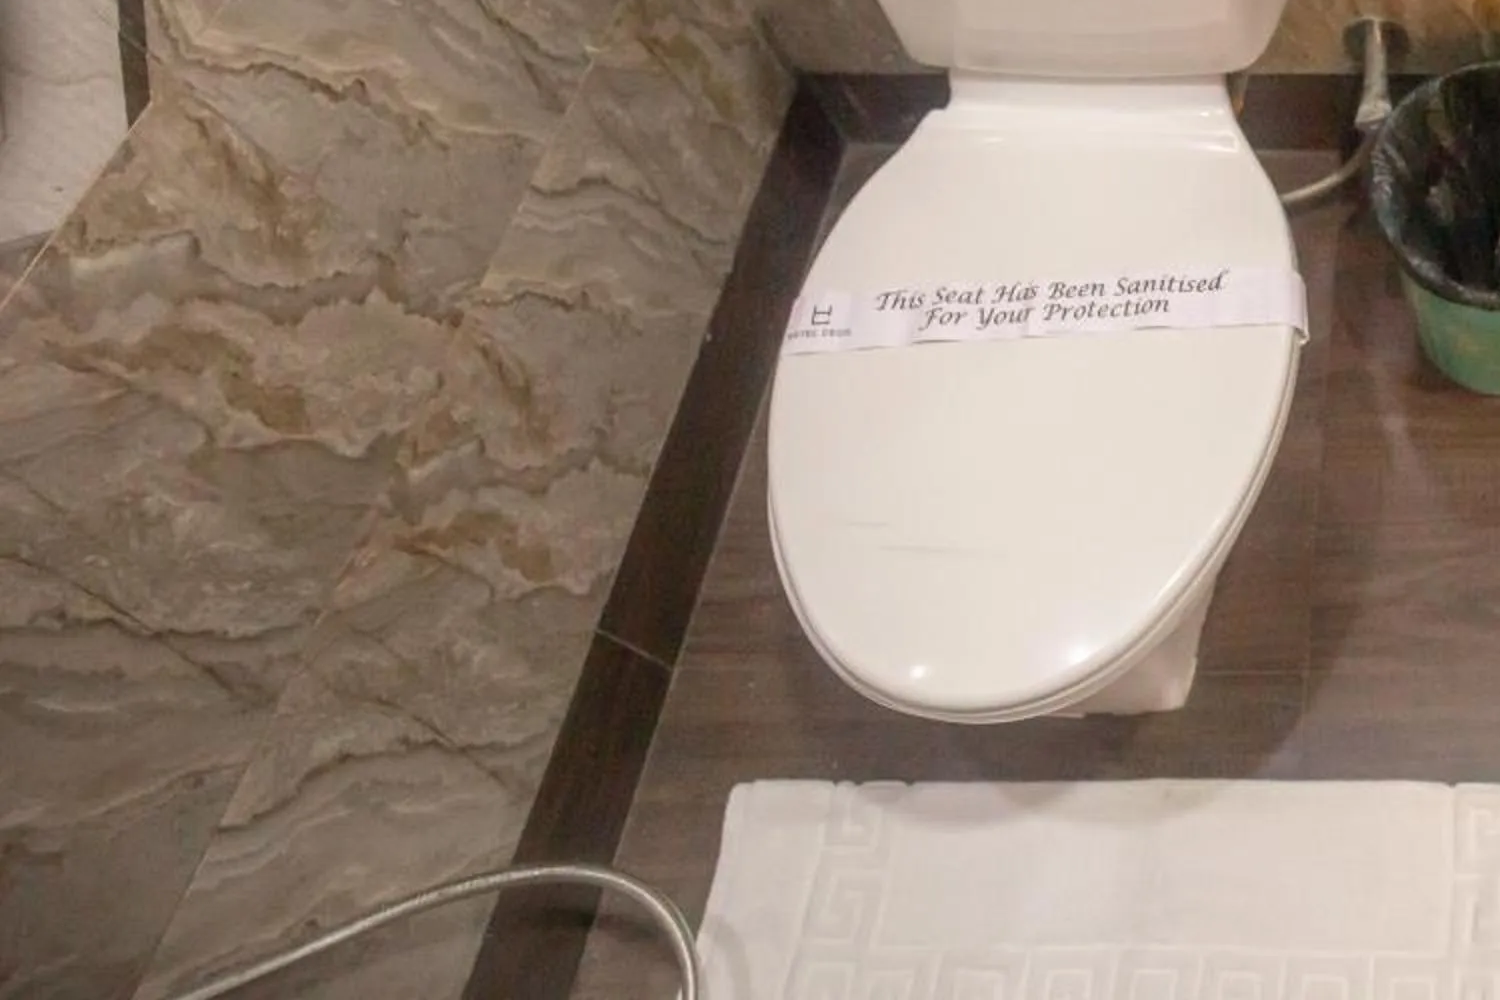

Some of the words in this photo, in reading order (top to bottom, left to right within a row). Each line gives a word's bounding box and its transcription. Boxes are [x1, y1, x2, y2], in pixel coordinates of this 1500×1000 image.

[876, 288, 926, 312] This
[931, 285, 985, 306] Seat
[991, 280, 1040, 304] Has
[1048, 280, 1105, 300] Been
[1113, 267, 1231, 297] Sanitised
[917, 306, 968, 332] For
[975, 307, 1036, 331] Your
[1042, 297, 1171, 322] Protection
